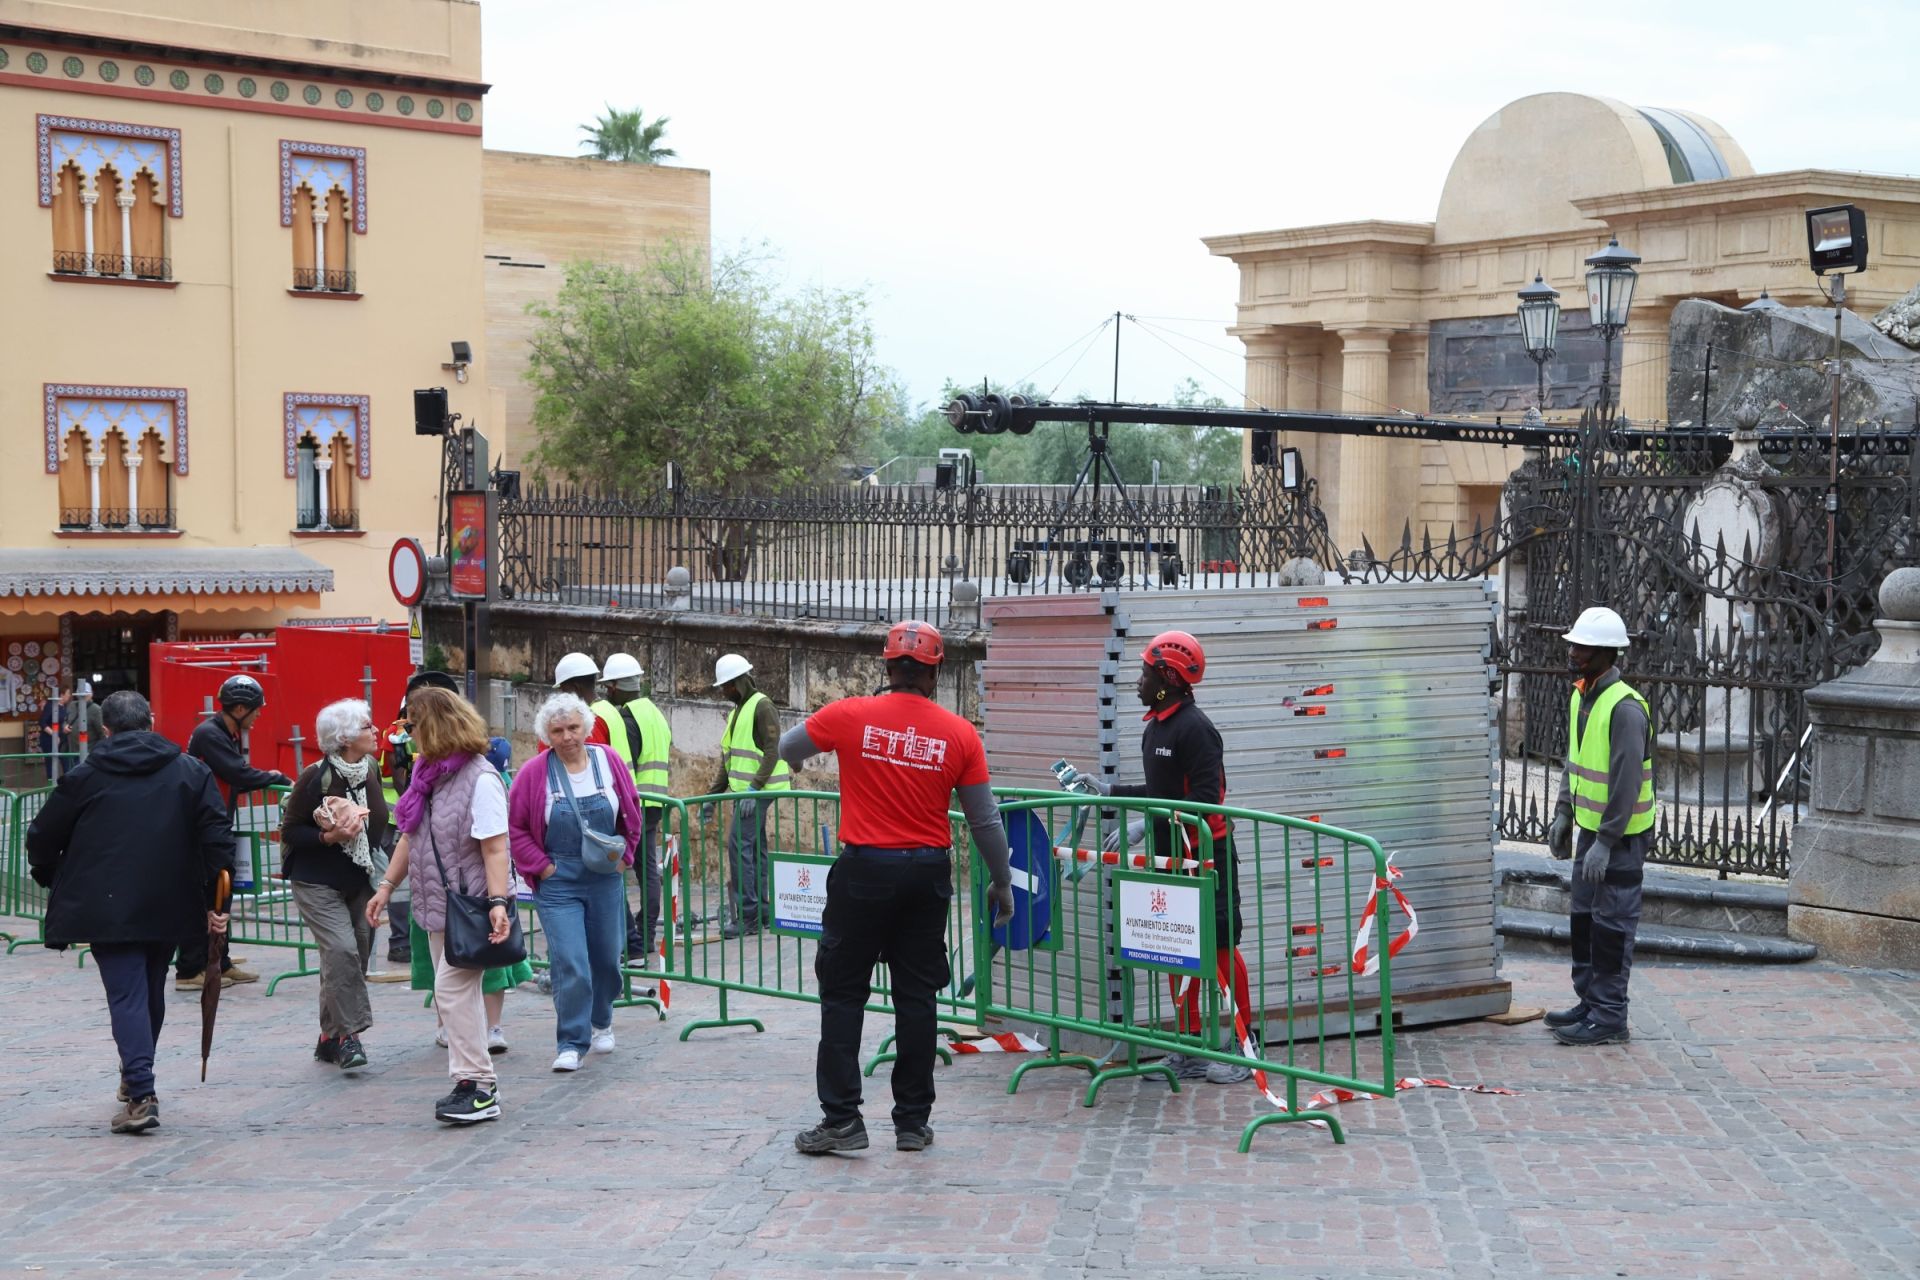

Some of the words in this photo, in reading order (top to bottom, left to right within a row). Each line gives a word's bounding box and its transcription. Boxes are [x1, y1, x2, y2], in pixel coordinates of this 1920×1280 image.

[1126, 917, 1161, 931] AYUNTAMIENTO
[1162, 922, 1169, 932] DE
[1152, 932, 1192, 945] Infraestructuras
[1128, 950, 1151, 960] PERDONEN
[1160, 955, 1183, 964] MOLESTIAS
